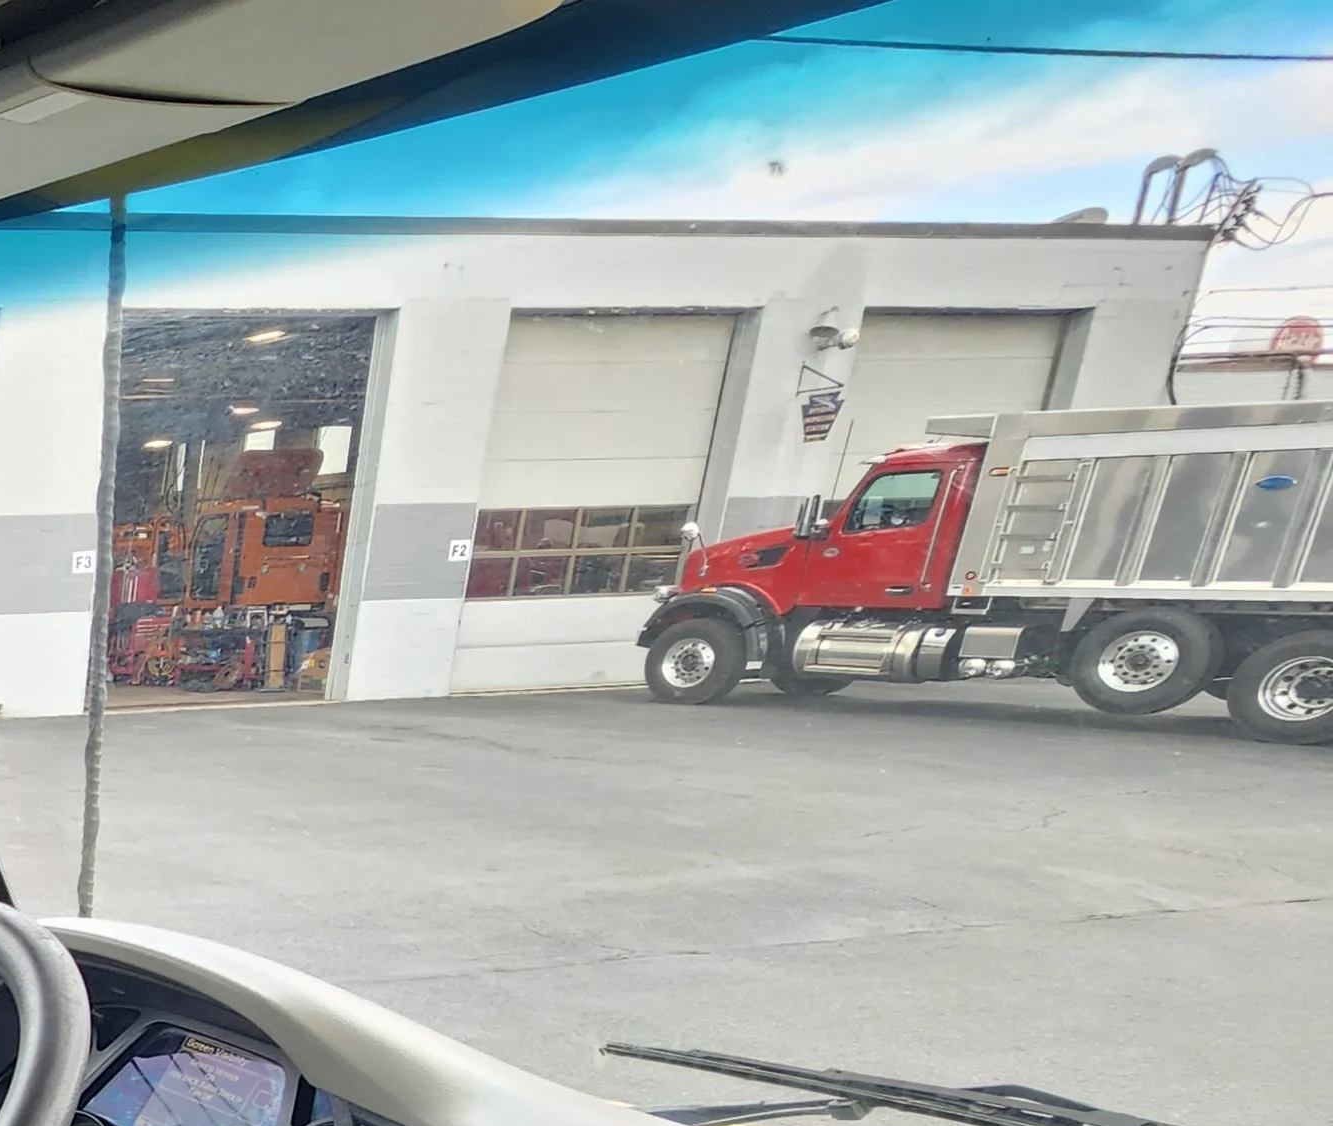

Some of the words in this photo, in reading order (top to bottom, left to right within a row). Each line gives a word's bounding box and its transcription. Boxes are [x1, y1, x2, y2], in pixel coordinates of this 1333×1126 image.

[451, 544, 467, 557] F2
[75, 556, 92, 569] F3
[186, 1038, 215, 1055] Screen
